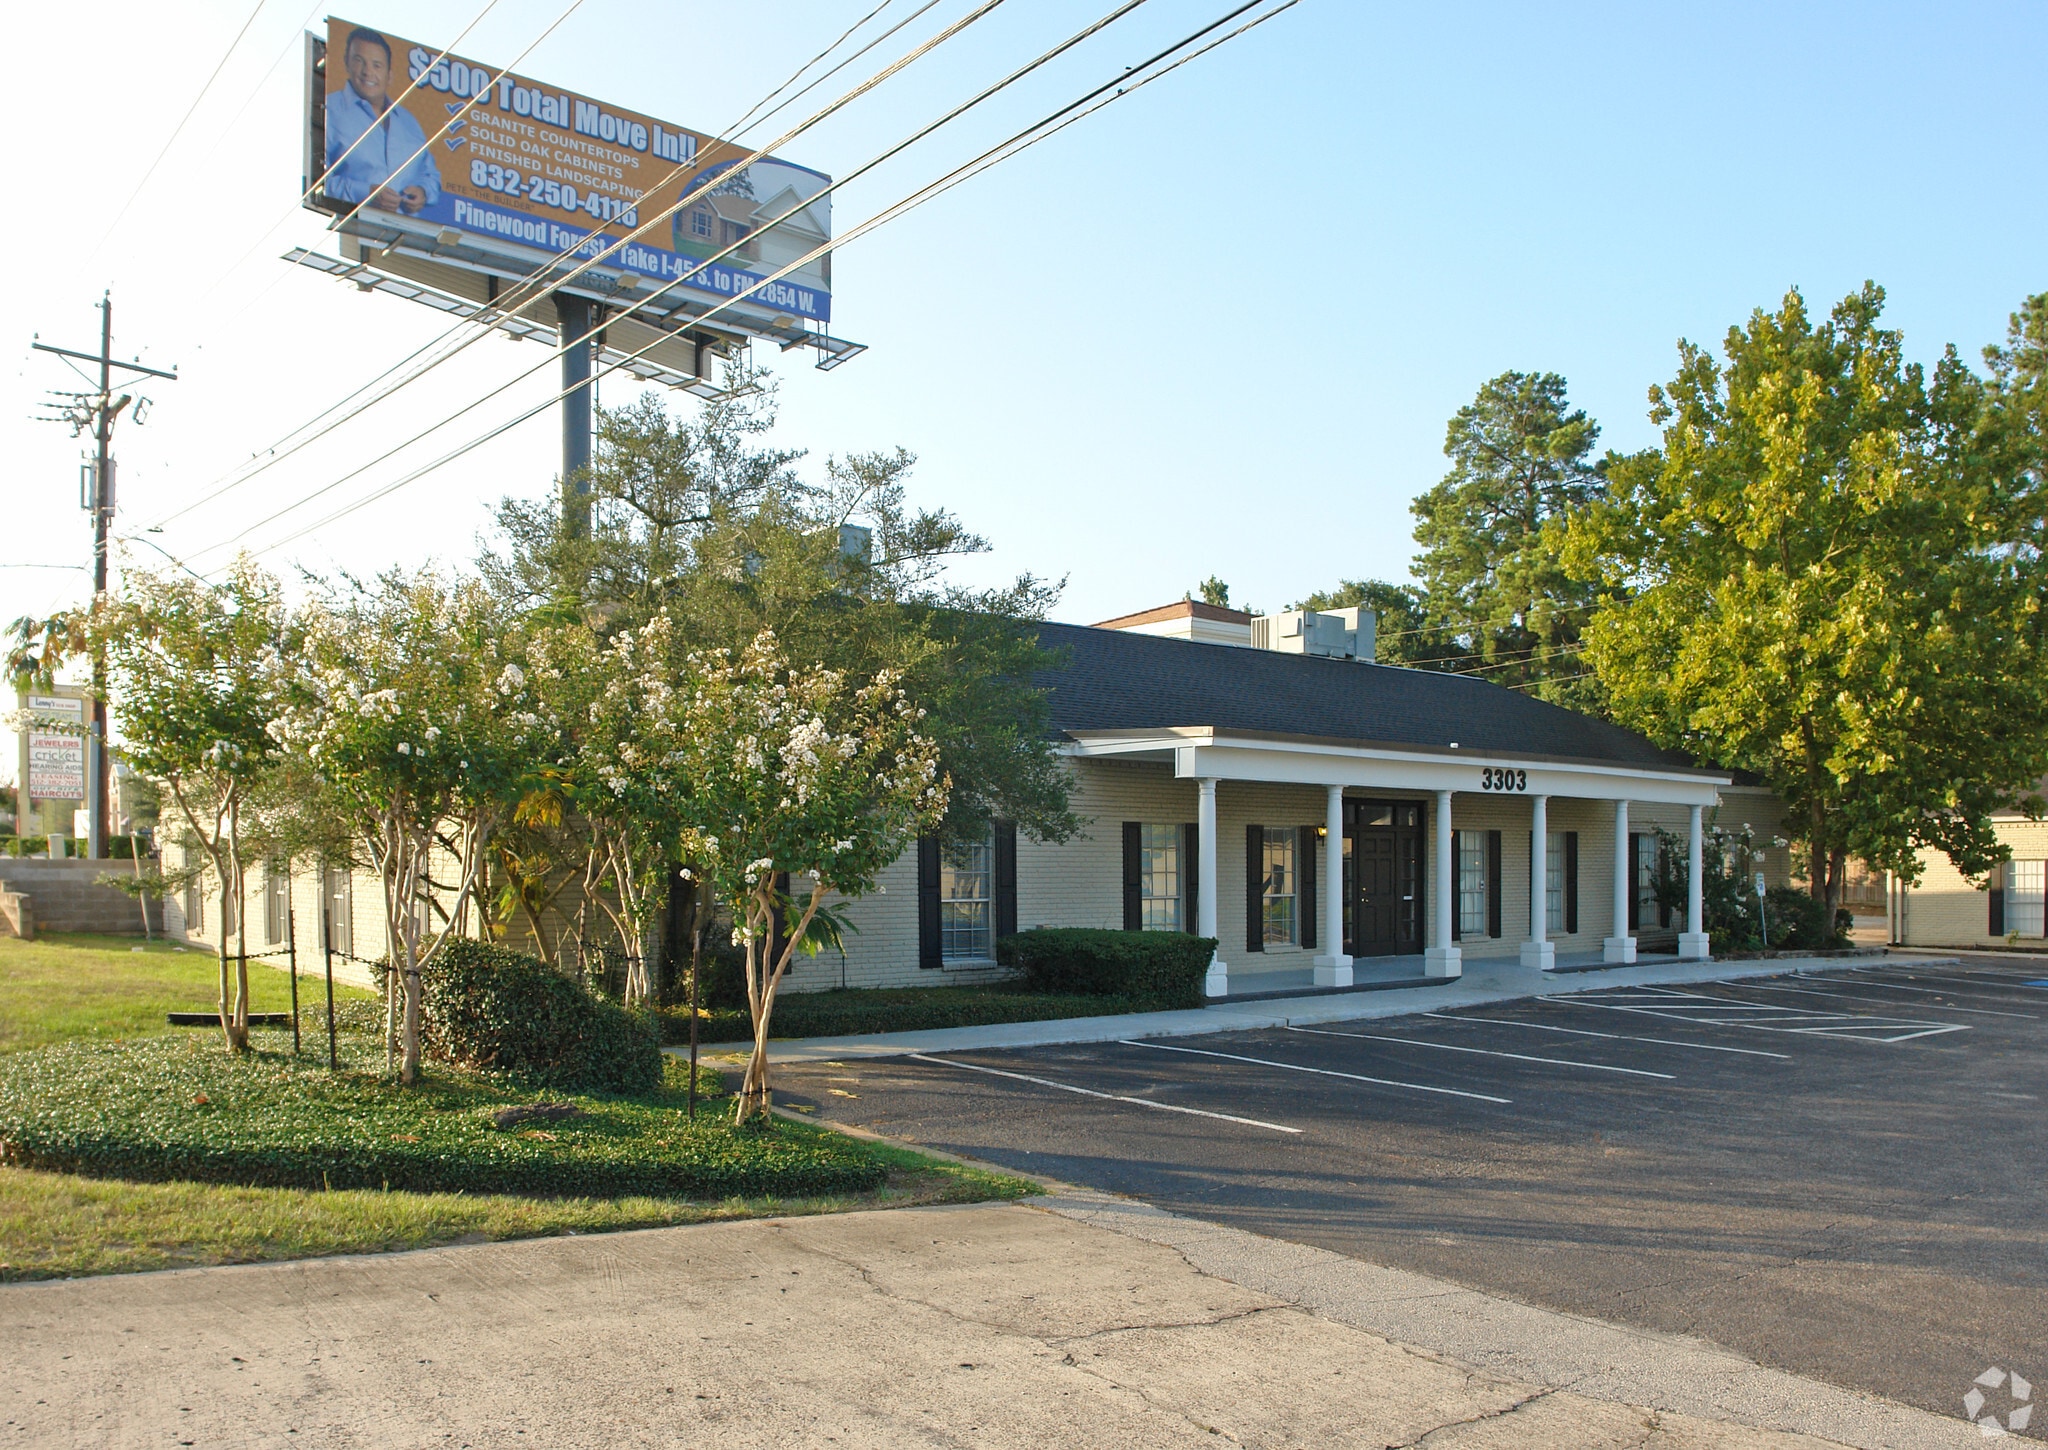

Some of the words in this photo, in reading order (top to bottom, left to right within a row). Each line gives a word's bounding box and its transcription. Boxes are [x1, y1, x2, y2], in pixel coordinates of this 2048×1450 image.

[408, 46, 491, 105] $500
[495, 74, 570, 130] Total
[574, 99, 649, 152] Move
[652, 122, 697, 169] In!!
[470, 109, 536, 138] GRANITE
[539, 130, 640, 169] COUNTERTOPS
[470, 125, 516, 148] SOLID
[520, 140, 550, 158] OAK
[554, 150, 623, 179] CABINETS
[446, 182, 467, 194] PETE
[470, 141, 542, 171] FINISHED
[546, 163, 644, 199] LANDSCAPING
[470, 158, 638, 229] 832-250-4116
[454, 199, 546, 244] Pinewood
[619, 243, 658, 272] Take
[661, 253, 694, 282] I-45
[697, 265, 711, 287] S.
[713, 269, 730, 291] to
[733, 272, 755, 297] FM
[757, 282, 796, 308] 2854
[798, 290, 817, 314] W.
[32, 739, 80, 748] JEWELERS
[35, 748, 77, 762] cricket
[30, 790, 82, 798] HAIRCUTS
[1482, 768, 1527, 791] 3303
